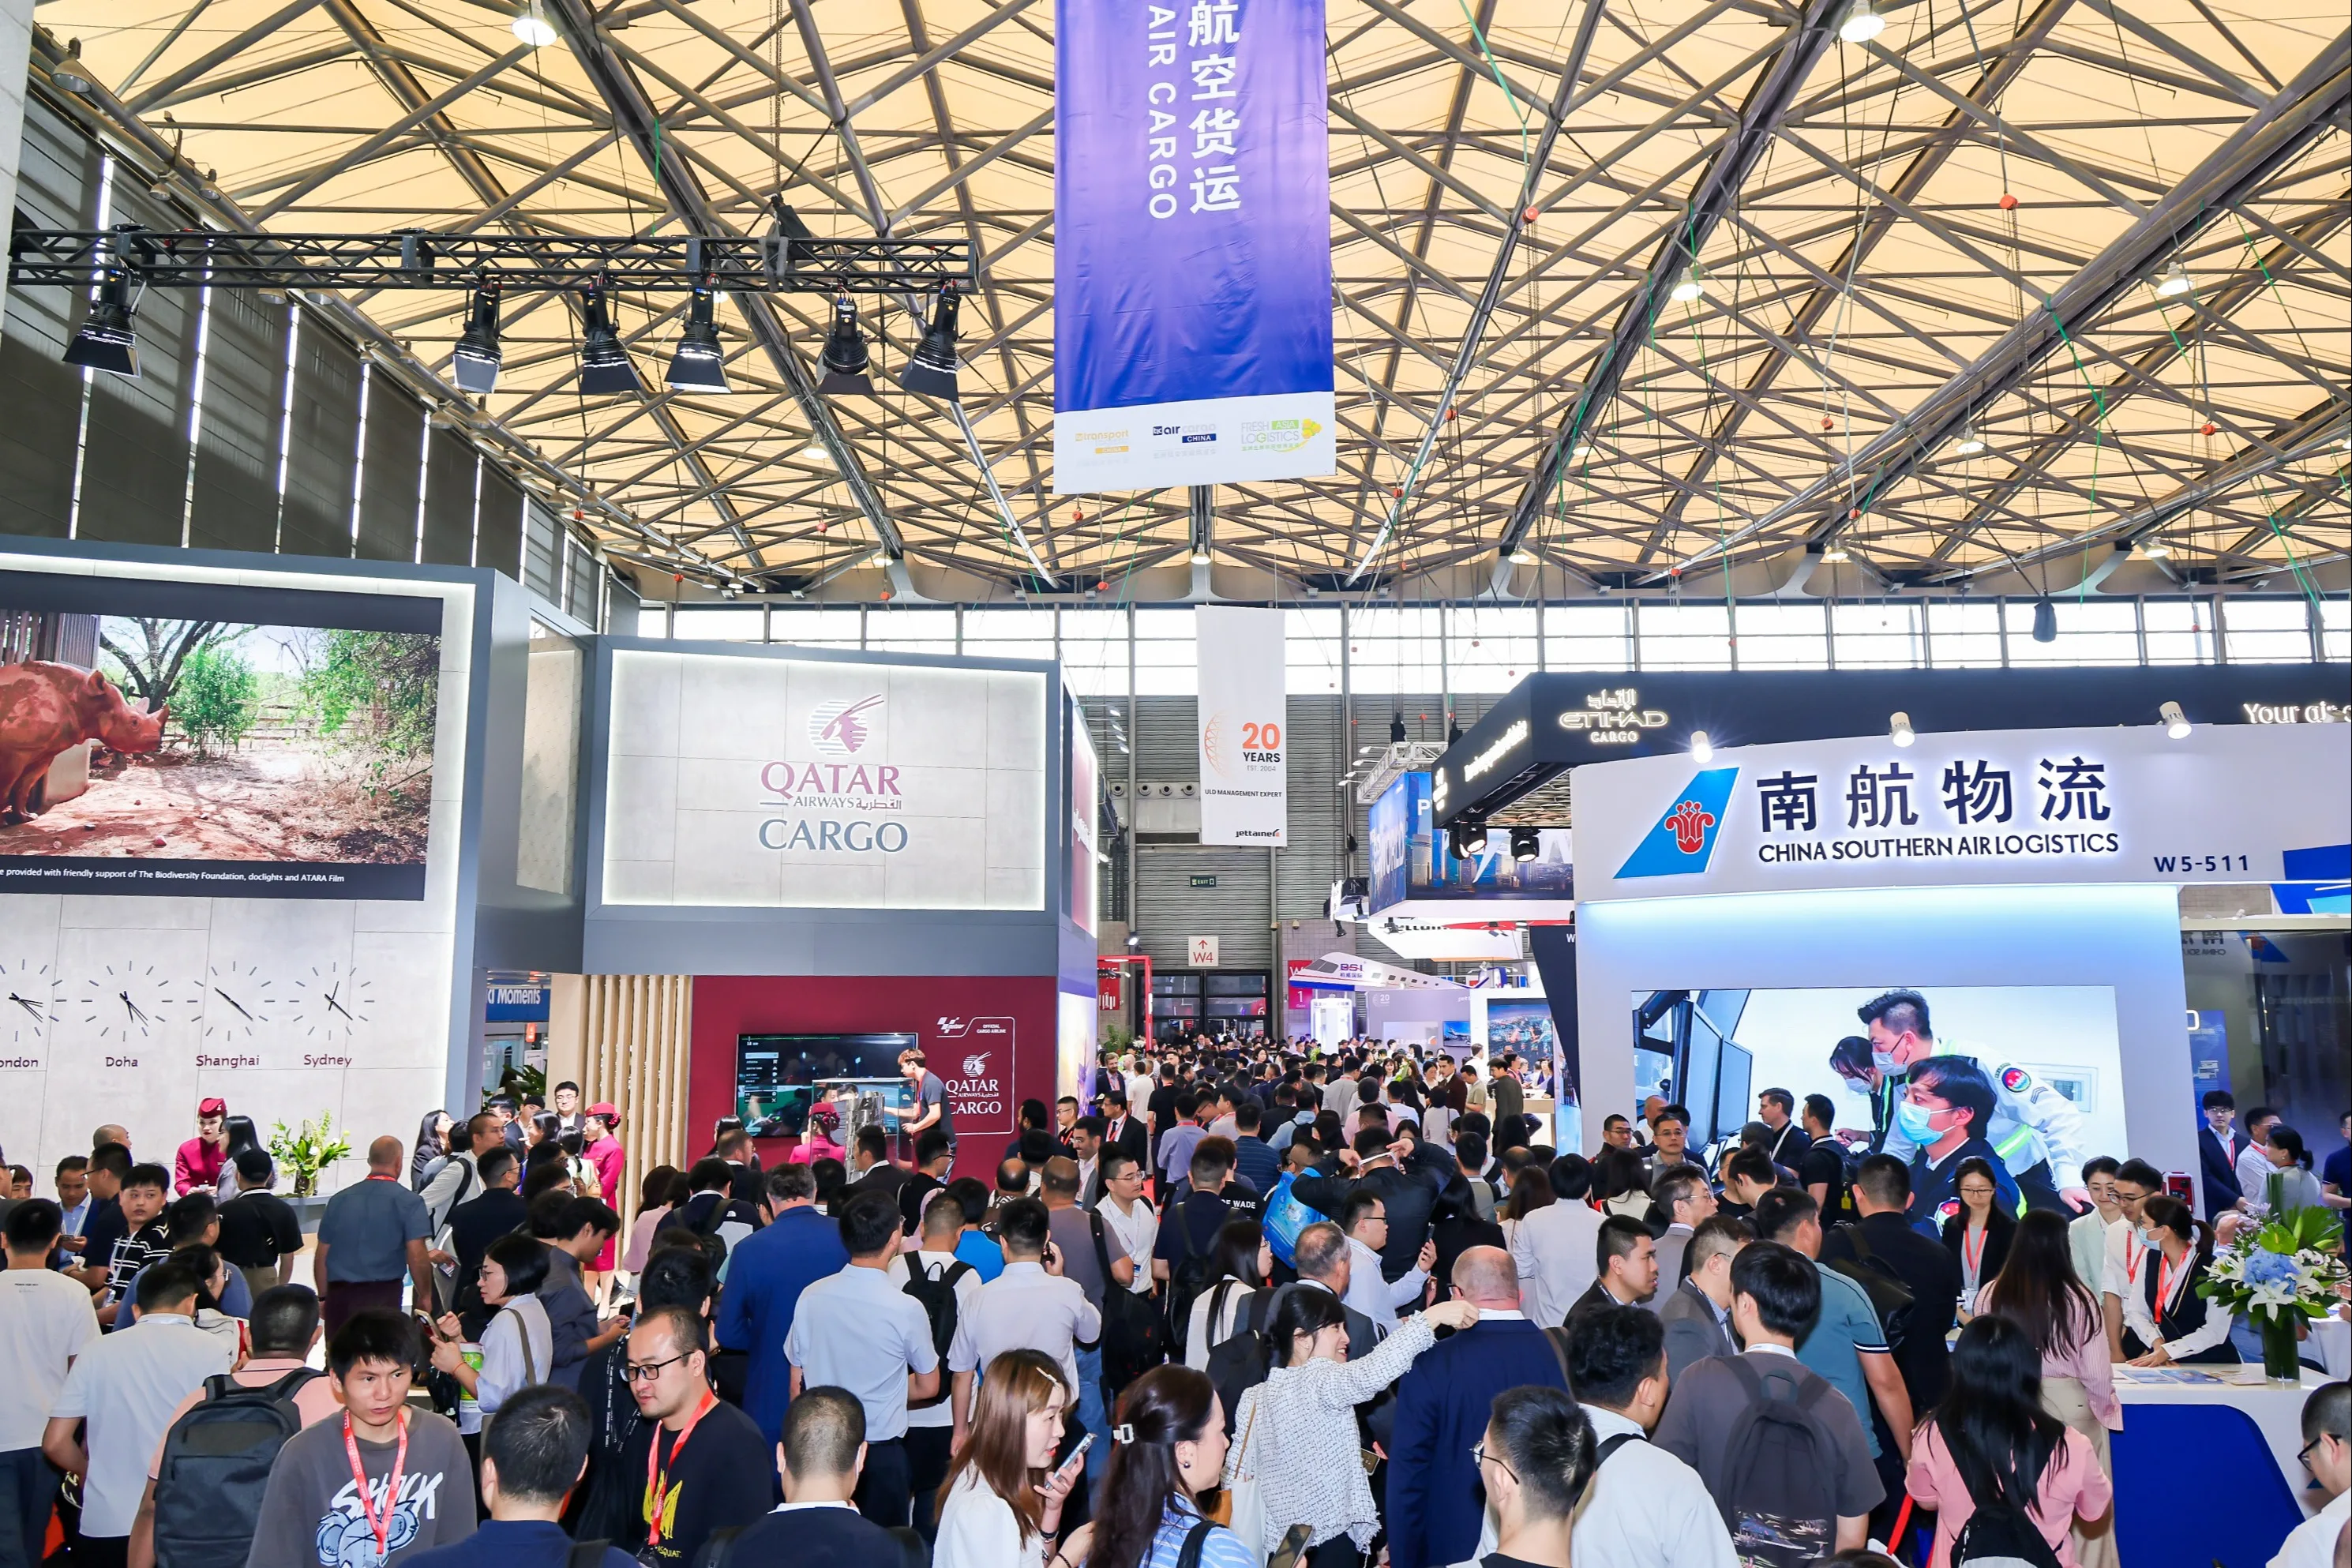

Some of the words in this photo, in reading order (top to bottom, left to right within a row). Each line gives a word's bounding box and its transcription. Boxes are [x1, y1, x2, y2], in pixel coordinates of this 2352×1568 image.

[1148, 5, 1176, 69] AIR
[1187, 0, 1241, 215] 航空货运
[1148, 81, 1177, 219] CARGO
[1164, 426, 1181, 435] air
[1241, 421, 1270, 433] FRESH
[1275, 420, 1296, 430] ASIA
[1084, 430, 1129, 441] transport
[1241, 430, 1300, 445] LOGISTICS
[1559, 711, 1668, 729] ETIHAD
[2243, 702, 2300, 724] Your
[1242, 722, 1281, 750] 20
[1590, 731, 1639, 743] CARGO
[1243, 752, 1281, 763] YEARS
[760, 761, 902, 800] QATAR
[793, 796, 854, 808] AIRWAYS
[1757, 756, 2111, 833] 南航物流
[856, 797, 902, 811] القطرية
[759, 819, 908, 853] CARGO
[1236, 829, 1280, 838] jettainer
[1758, 842, 1827, 863] CHINA
[1832, 837, 1953, 861] SOUTHERN
[1958, 835, 1993, 856] AIR
[1996, 832, 2119, 854] LOGISTICS
[6, 868, 42, 876] provided
[63, 868, 93, 879] friendly
[139, 870, 153, 879] The
[155, 870, 199, 880] Biodiversity
[201, 872, 246, 881] Foundation,
[284, 873, 298, 882] and
[328, 874, 344, 883] Film
[1193, 951, 1214, 963] W4
[1340, 963, 1364, 972] BSI
[497, 988, 541, 1005] Moments
[1297, 990, 1304, 1003] 1
[106, 1056, 138, 1067] Doha
[196, 1055, 260, 1068] Shanghai
[303, 1054, 352, 1069] Sydney
[946, 1079, 999, 1094] QATAR
[1232, 1200, 1256, 1209] WADE
